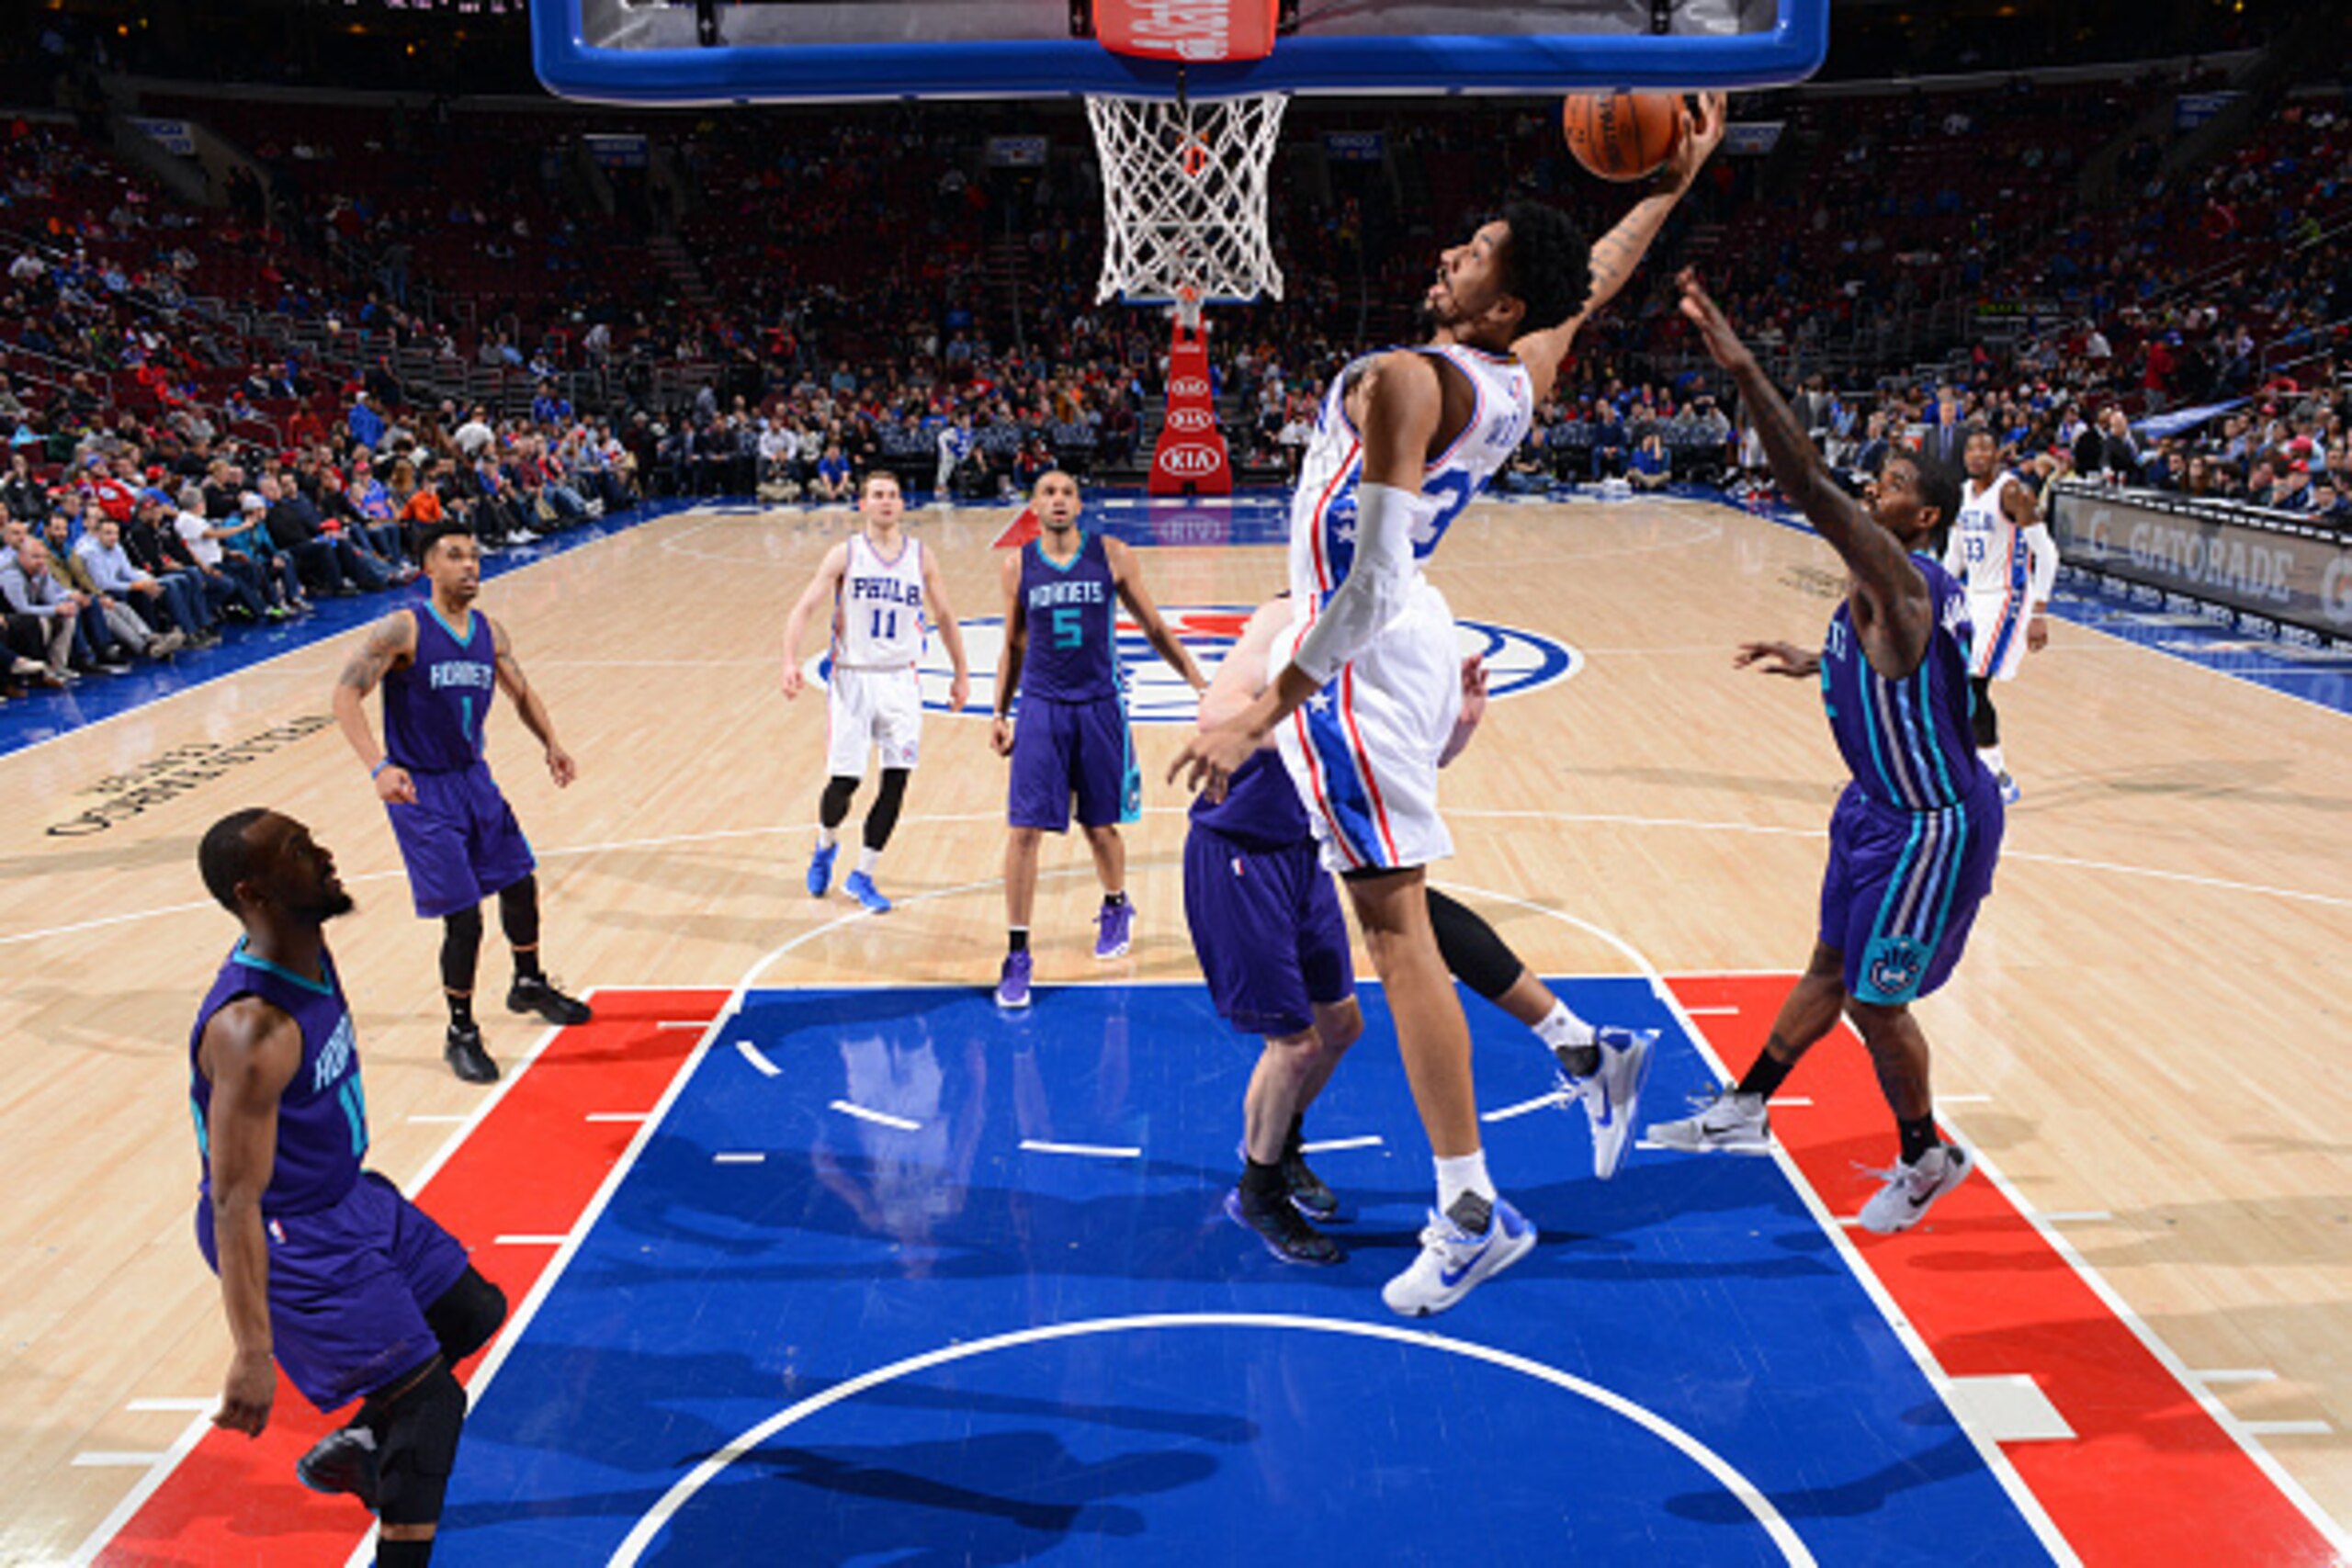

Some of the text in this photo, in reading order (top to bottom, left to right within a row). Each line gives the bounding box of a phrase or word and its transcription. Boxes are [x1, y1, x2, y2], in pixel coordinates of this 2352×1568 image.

[1172, 451, 1209, 468] KIA
[2130, 520, 2294, 603] GATORADE
[852, 577, 921, 606] PHILA
[1029, 581, 1105, 610] HORNETS
[870, 608, 897, 639] 11
[1053, 607, 1083, 649] 5
[460, 695, 472, 741] 1
